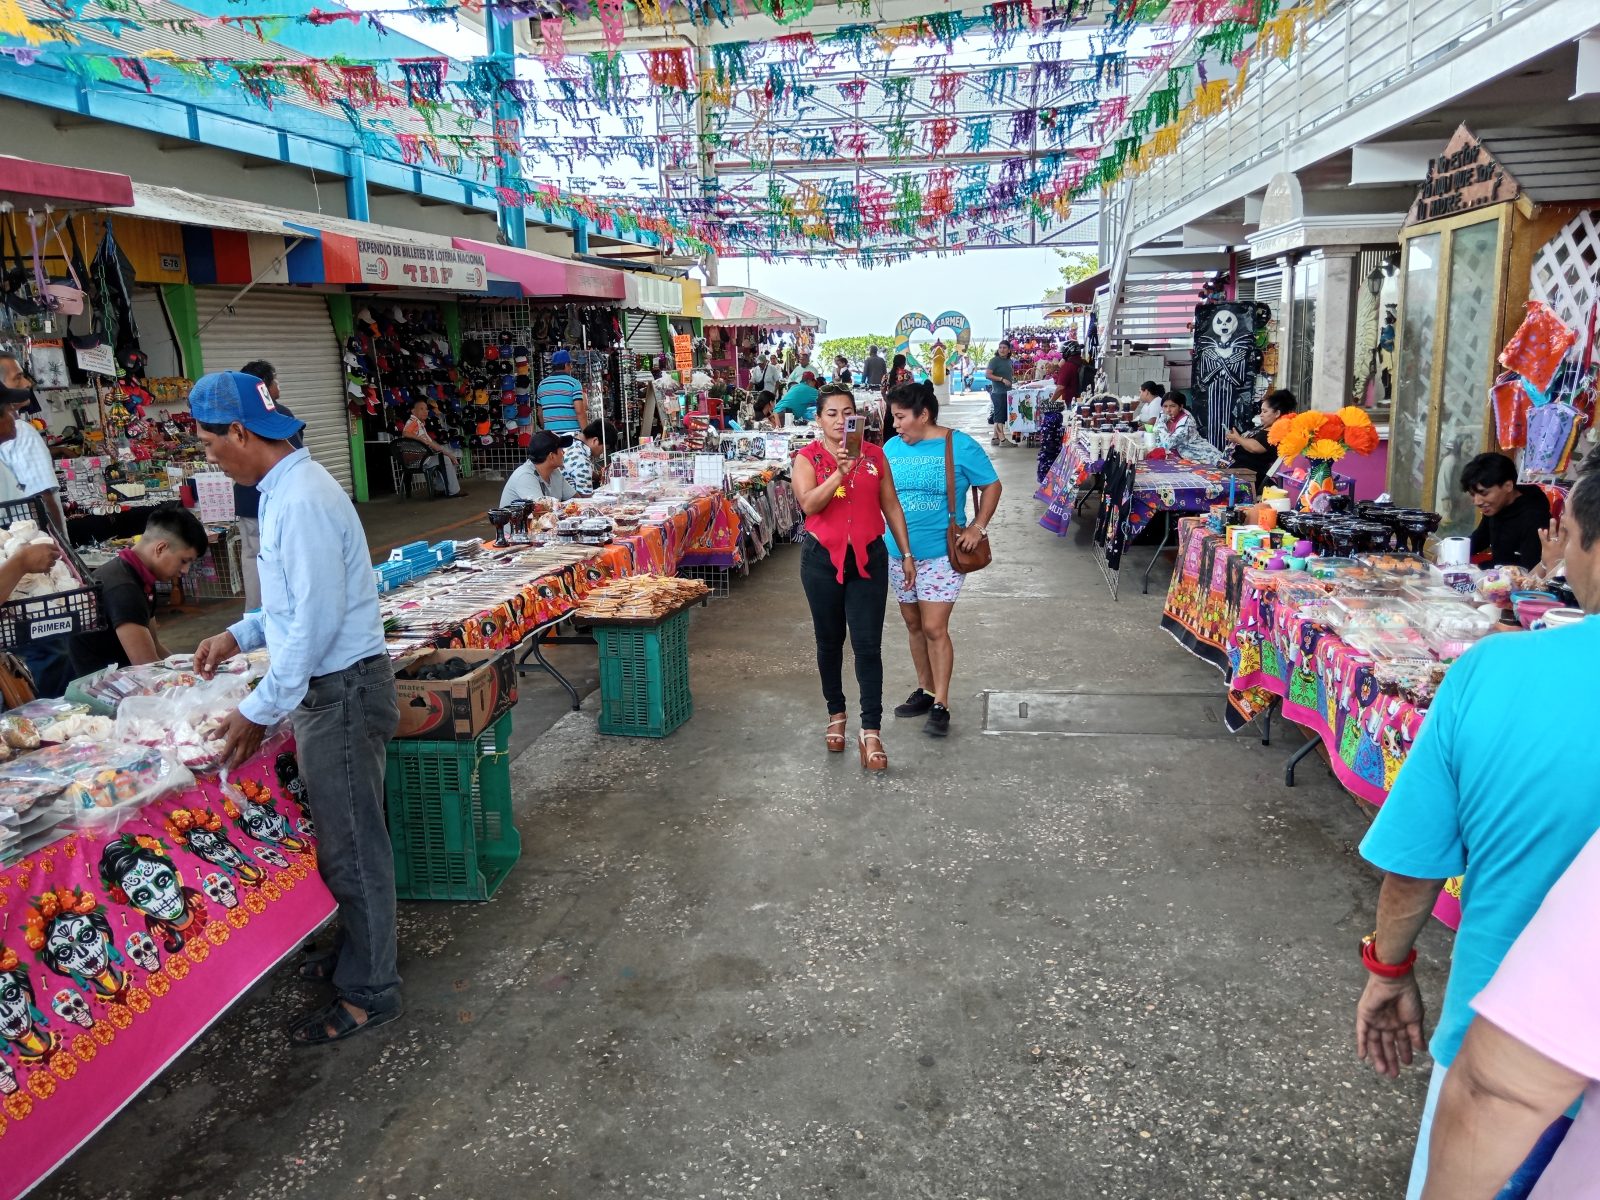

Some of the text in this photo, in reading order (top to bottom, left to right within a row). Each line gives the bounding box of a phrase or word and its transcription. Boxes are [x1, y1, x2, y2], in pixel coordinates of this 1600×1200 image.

[358, 240, 391, 256] EXPENDIO
[393, 244, 401, 257] DE
[402, 246, 426, 261] BILLETES
[427, 249, 434, 261] DE
[457, 252, 485, 266] NACIONAL
[901, 316, 928, 331] AMOR
[936, 316, 965, 328] CARMEN
[908, 501, 941, 511] NOW
[31, 620, 71, 635] PRIMERA
